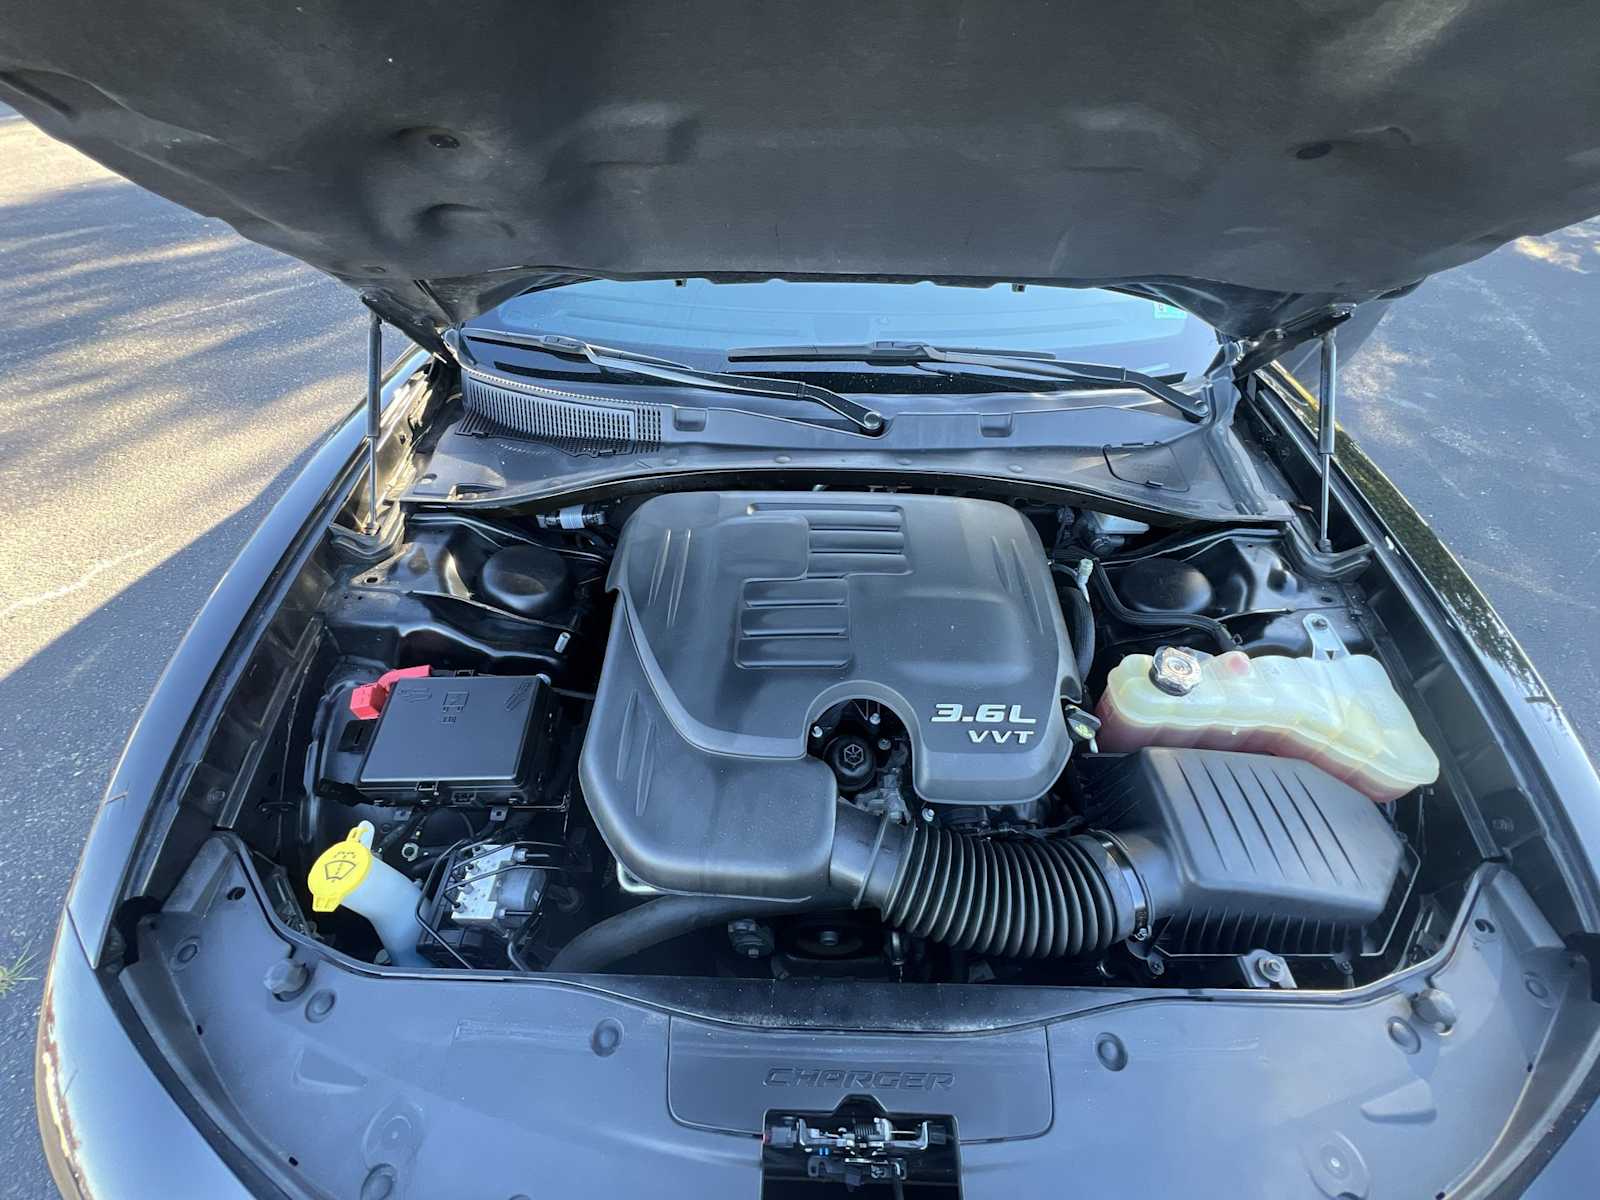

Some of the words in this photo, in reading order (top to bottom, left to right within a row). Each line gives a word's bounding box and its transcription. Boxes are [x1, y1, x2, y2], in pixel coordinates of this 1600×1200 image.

[931, 703, 1037, 724] 3.6L
[968, 730, 1035, 744] VVT
[763, 1067, 956, 1090] CHARGER
